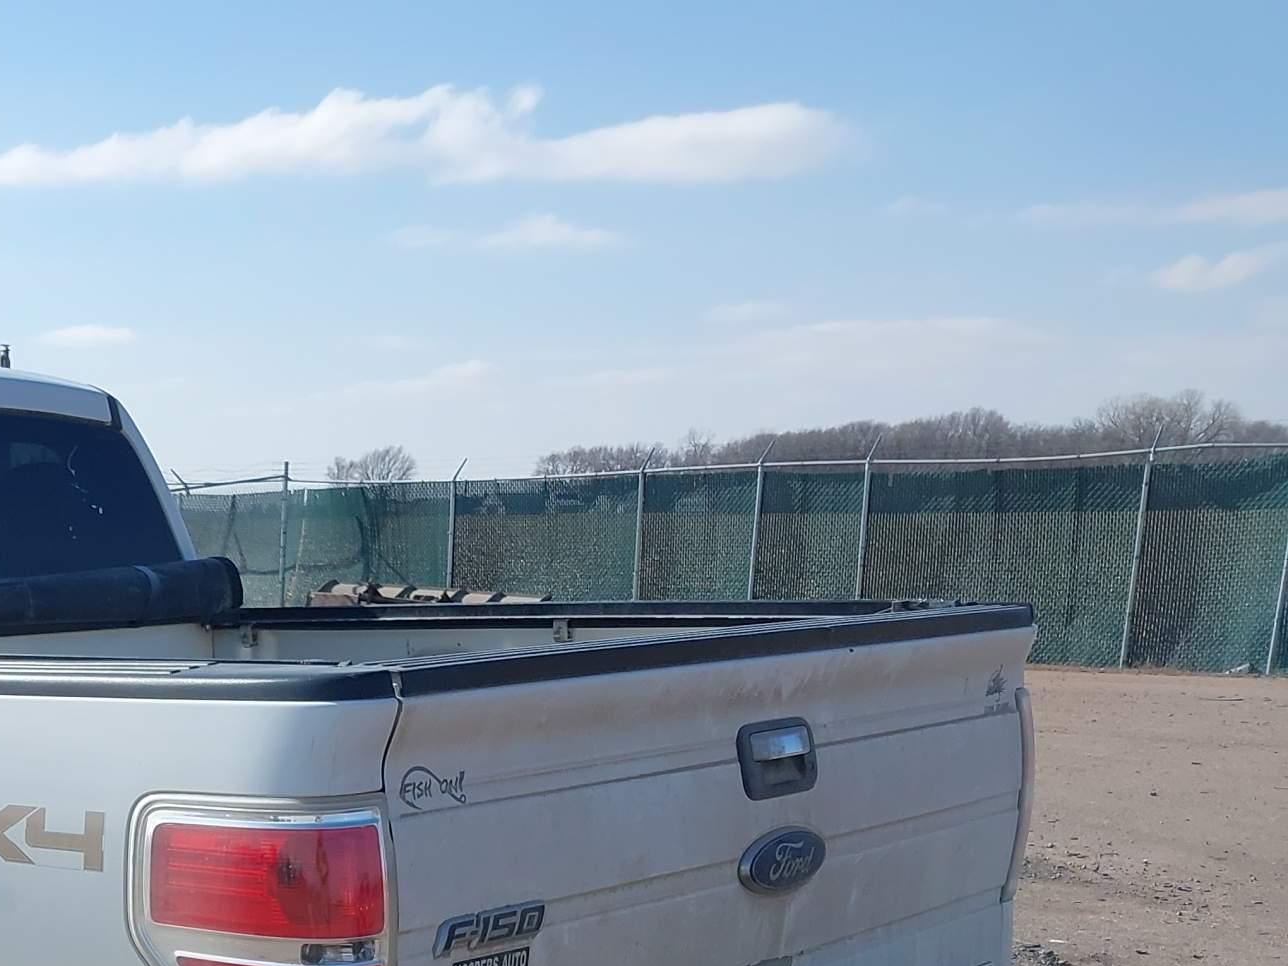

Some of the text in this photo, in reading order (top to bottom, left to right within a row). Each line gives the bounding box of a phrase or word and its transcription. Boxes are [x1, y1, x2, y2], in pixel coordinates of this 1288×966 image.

[403, 778, 432, 801] FISH
[769, 840, 816, 881] Ford
[435, 902, 545, 954] F-150
